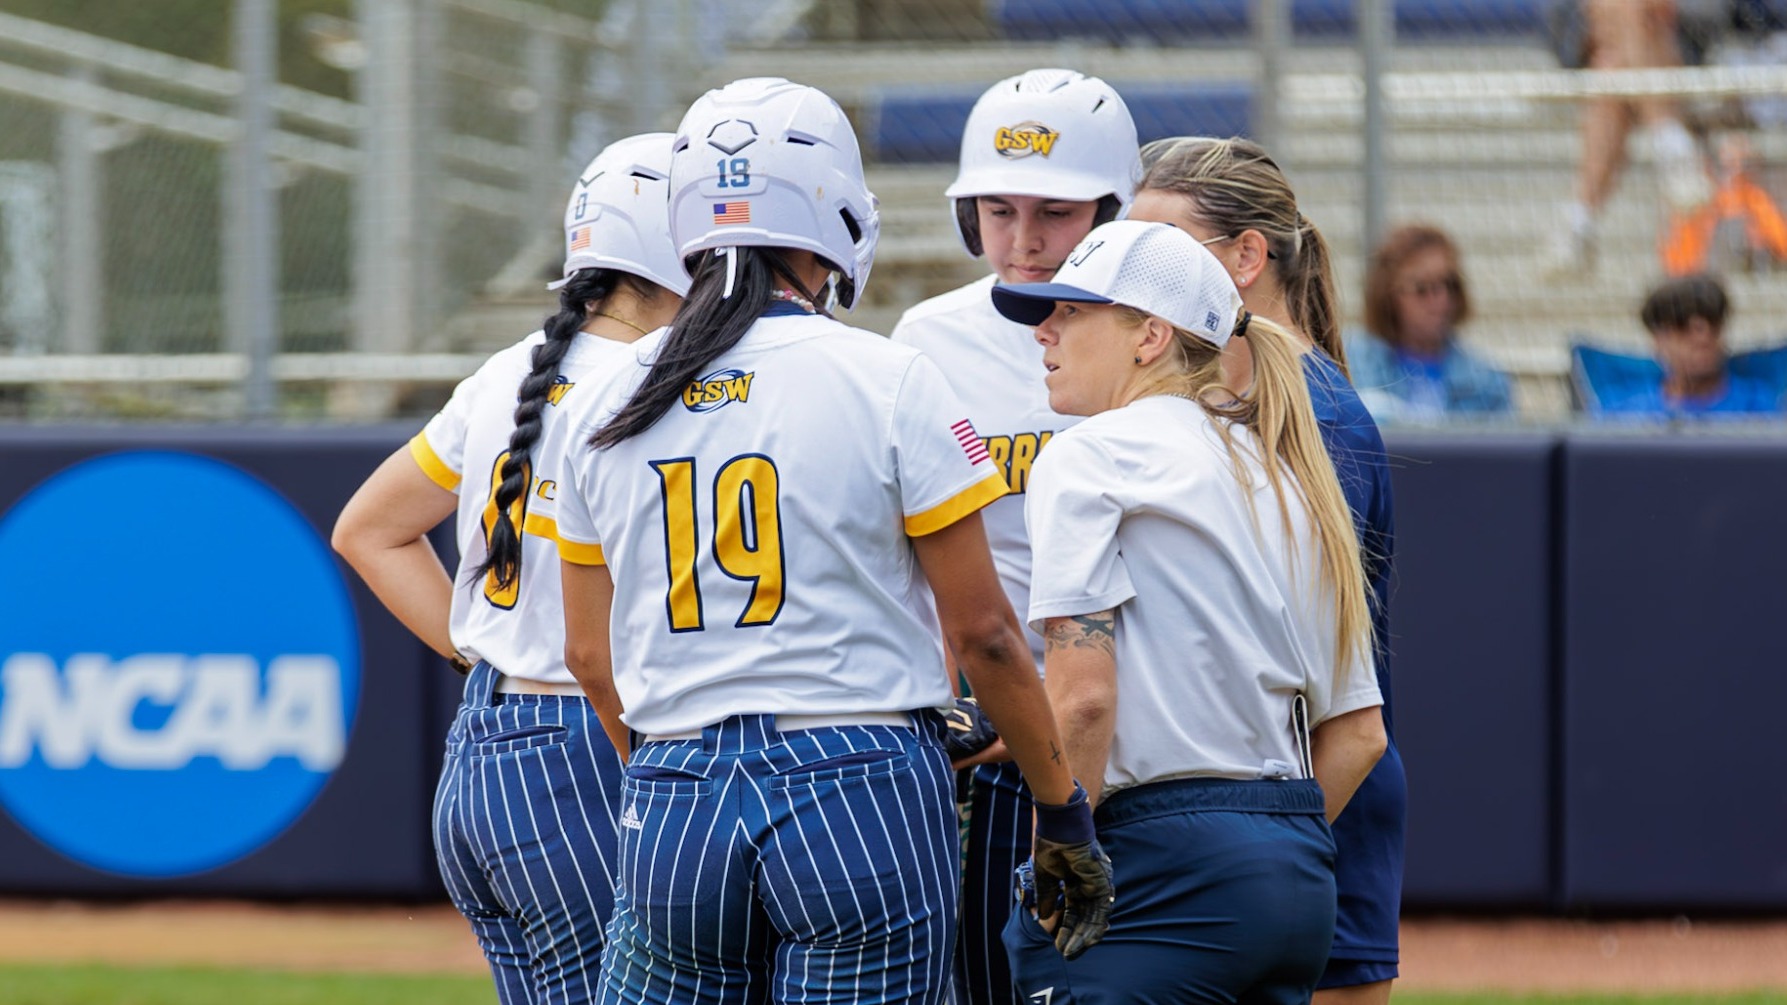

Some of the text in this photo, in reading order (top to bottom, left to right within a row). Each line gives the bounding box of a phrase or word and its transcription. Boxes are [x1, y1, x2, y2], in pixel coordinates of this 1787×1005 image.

[994, 126, 1060, 158] GSW
[716, 158, 751, 188] 19
[682, 371, 755, 408] GSW
[648, 453, 786, 634] 19
[0, 652, 346, 772] NCAA
